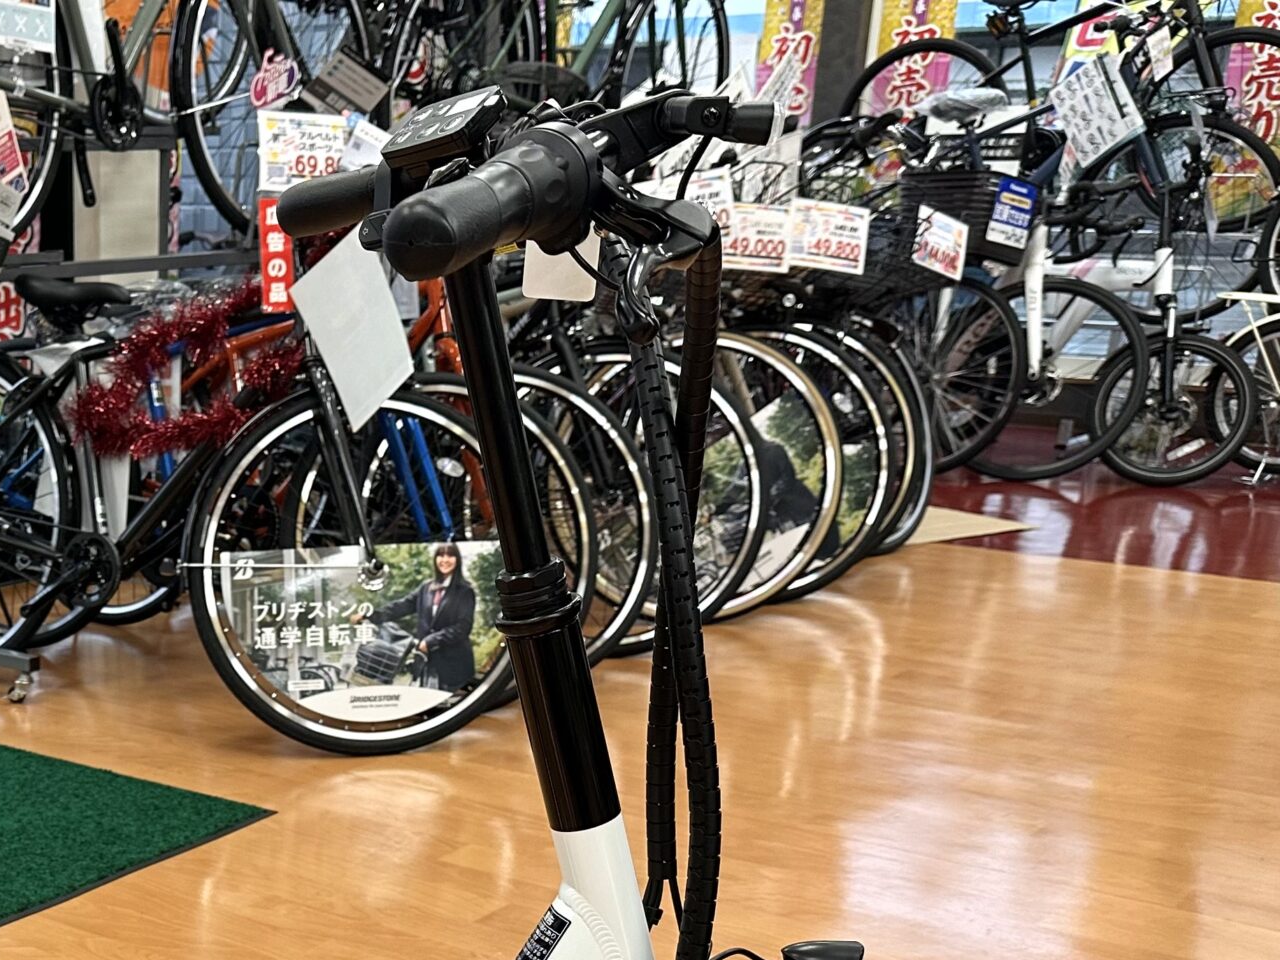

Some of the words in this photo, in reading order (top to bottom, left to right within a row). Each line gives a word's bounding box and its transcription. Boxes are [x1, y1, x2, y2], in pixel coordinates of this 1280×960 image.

[253, 601, 374, 622] ブリヂストンの
[254, 623, 376, 649] 通学自転車
